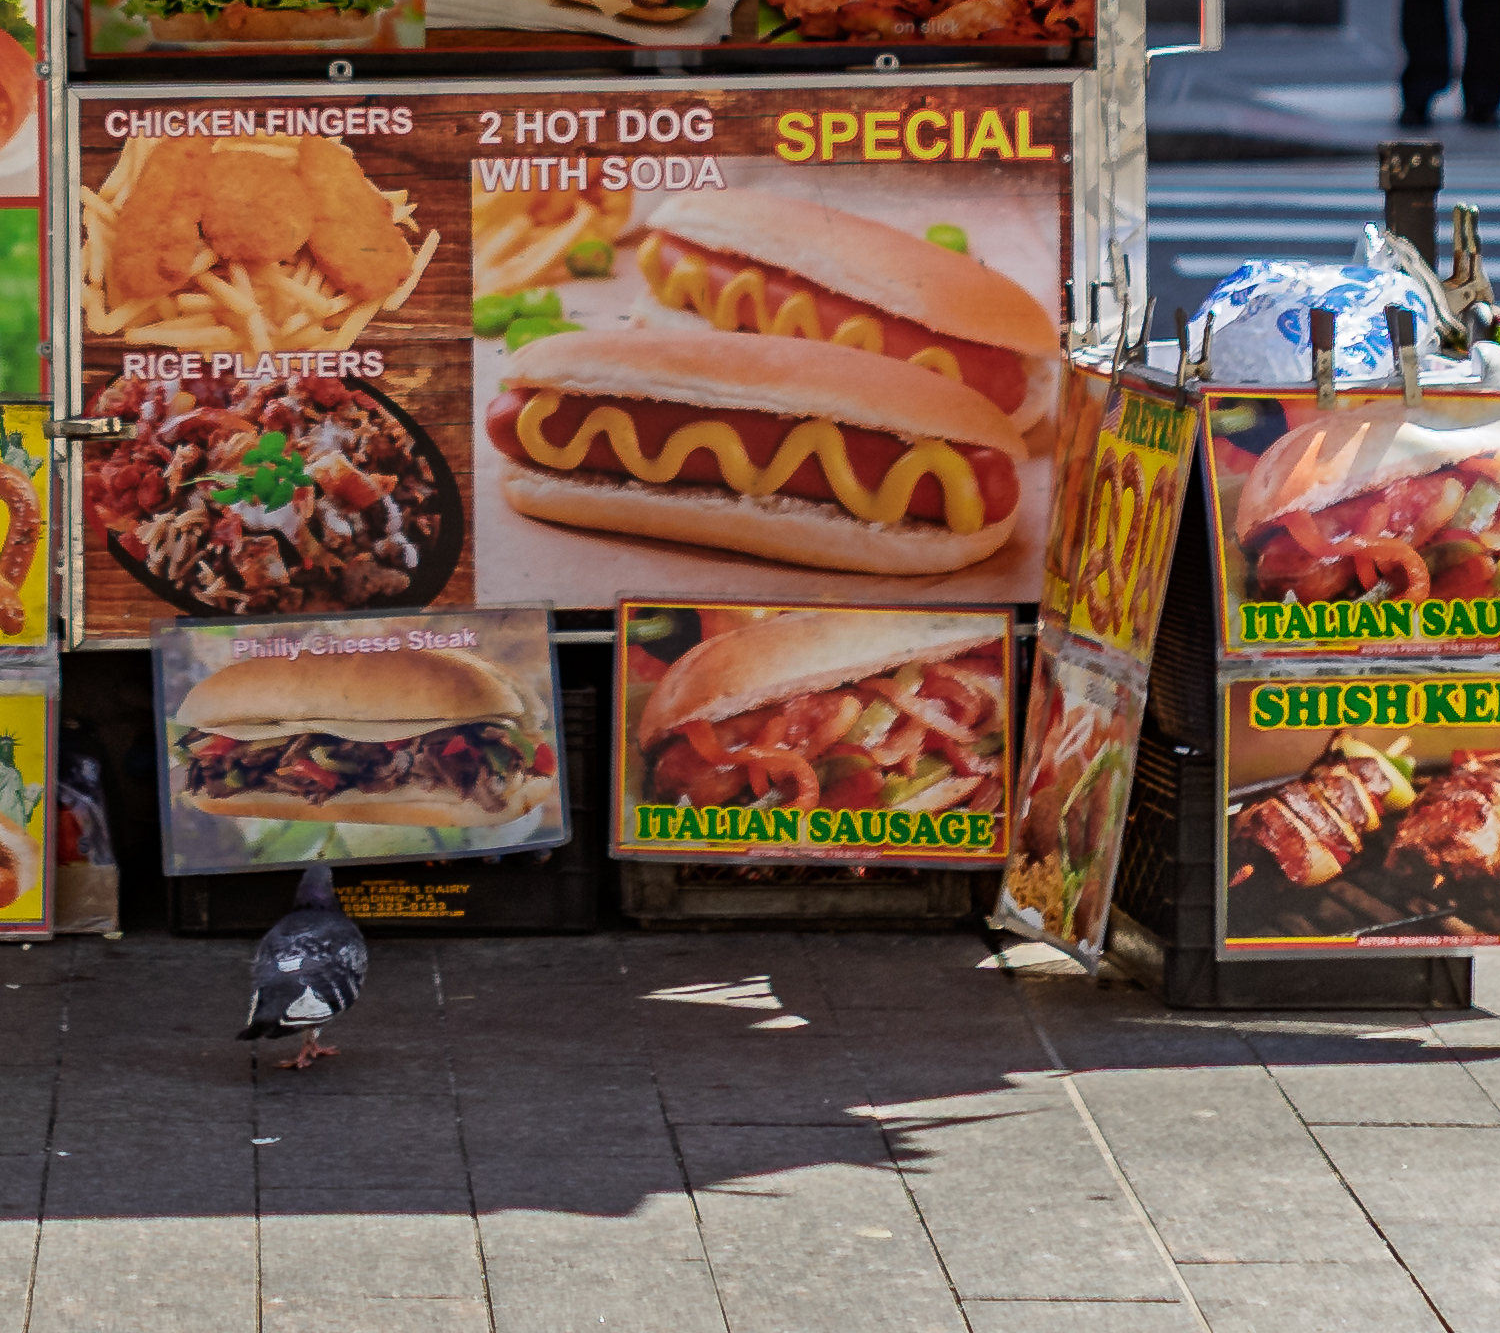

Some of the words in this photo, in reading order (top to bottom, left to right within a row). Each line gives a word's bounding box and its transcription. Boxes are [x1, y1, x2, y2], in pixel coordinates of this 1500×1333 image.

[104, 109, 256, 139] CHICKEN
[264, 106, 414, 137] FINGERS
[479, 112, 503, 145] 2
[512, 110, 602, 144] HOT
[613, 108, 716, 143] DOG
[774, 107, 1056, 164] SPECIAL
[479, 159, 592, 193] WITH
[600, 156, 727, 193] SODA
[122, 351, 206, 381] RICE
[209, 348, 386, 381] PLATTERS
[1240, 600, 1412, 643] ITALIAN
[231, 638, 302, 661] Philly
[308, 634, 402, 656] Cheese
[406, 626, 479, 651] Steak
[1252, 680, 1412, 731] SHISH
[636, 803, 801, 845] ITALIAN
[808, 806, 996, 849] SAUSAGE
[370, 885, 421, 894] FARMS
[426, 884, 470, 894] DAIRY
[415, 894, 435, 903] PA
